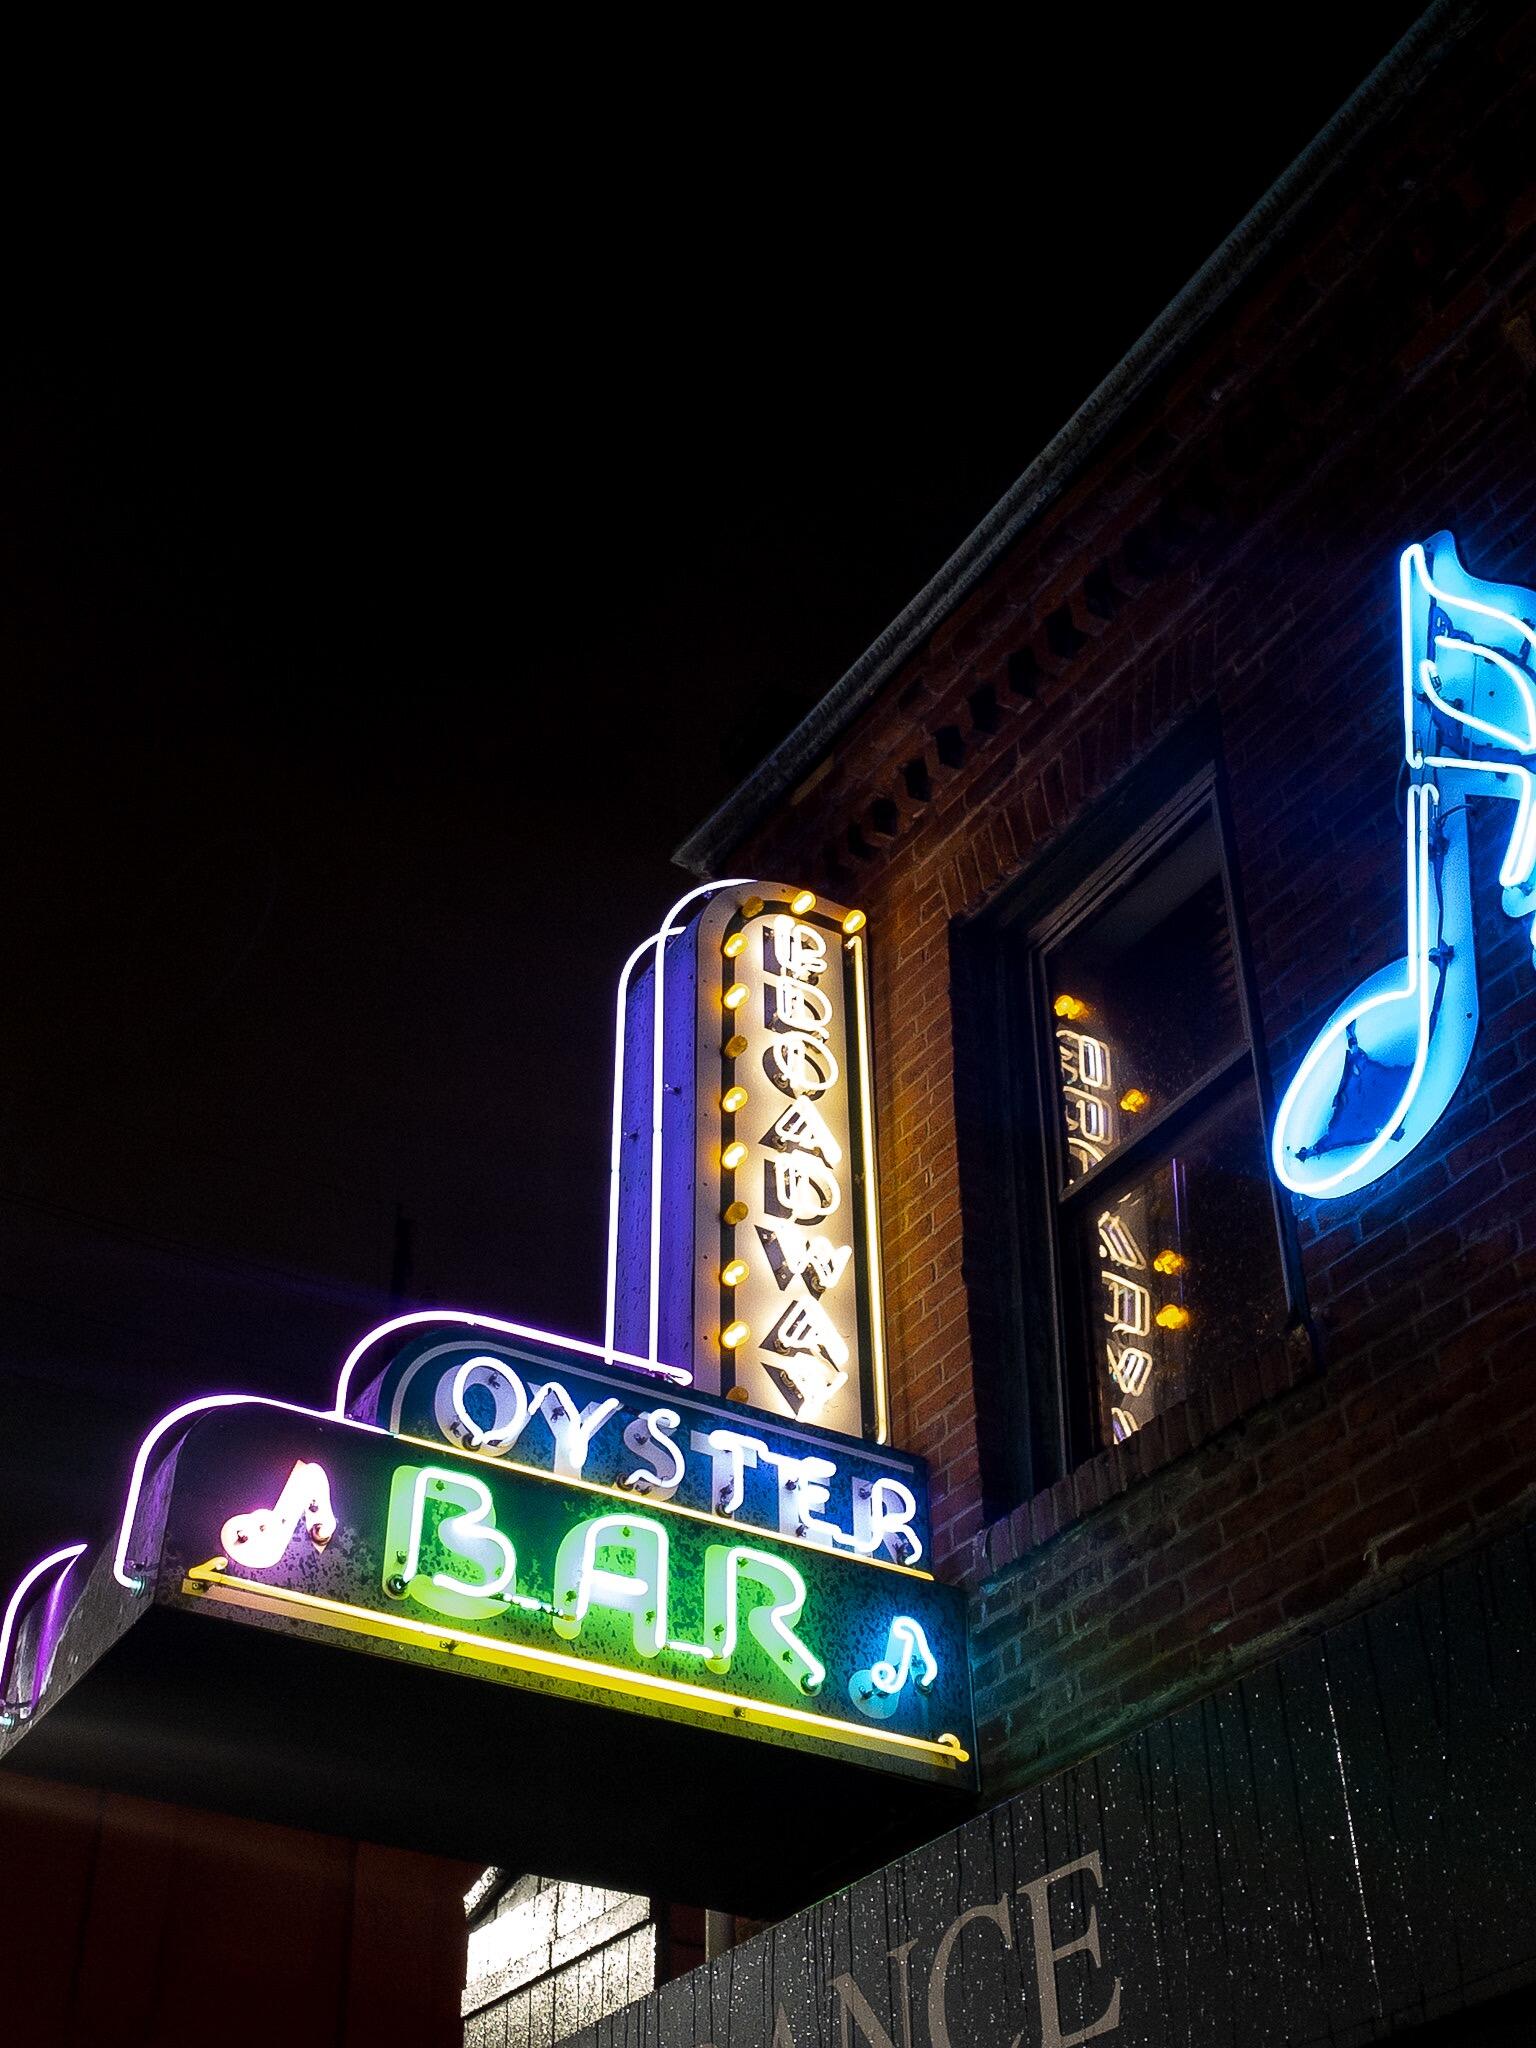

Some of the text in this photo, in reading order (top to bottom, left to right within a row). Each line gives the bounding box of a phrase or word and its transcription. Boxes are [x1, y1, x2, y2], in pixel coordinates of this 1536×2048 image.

[755, 914, 852, 1422] BROADWAY
[435, 1356, 922, 1565] OYSTER
[384, 1465, 825, 1695] BAR
